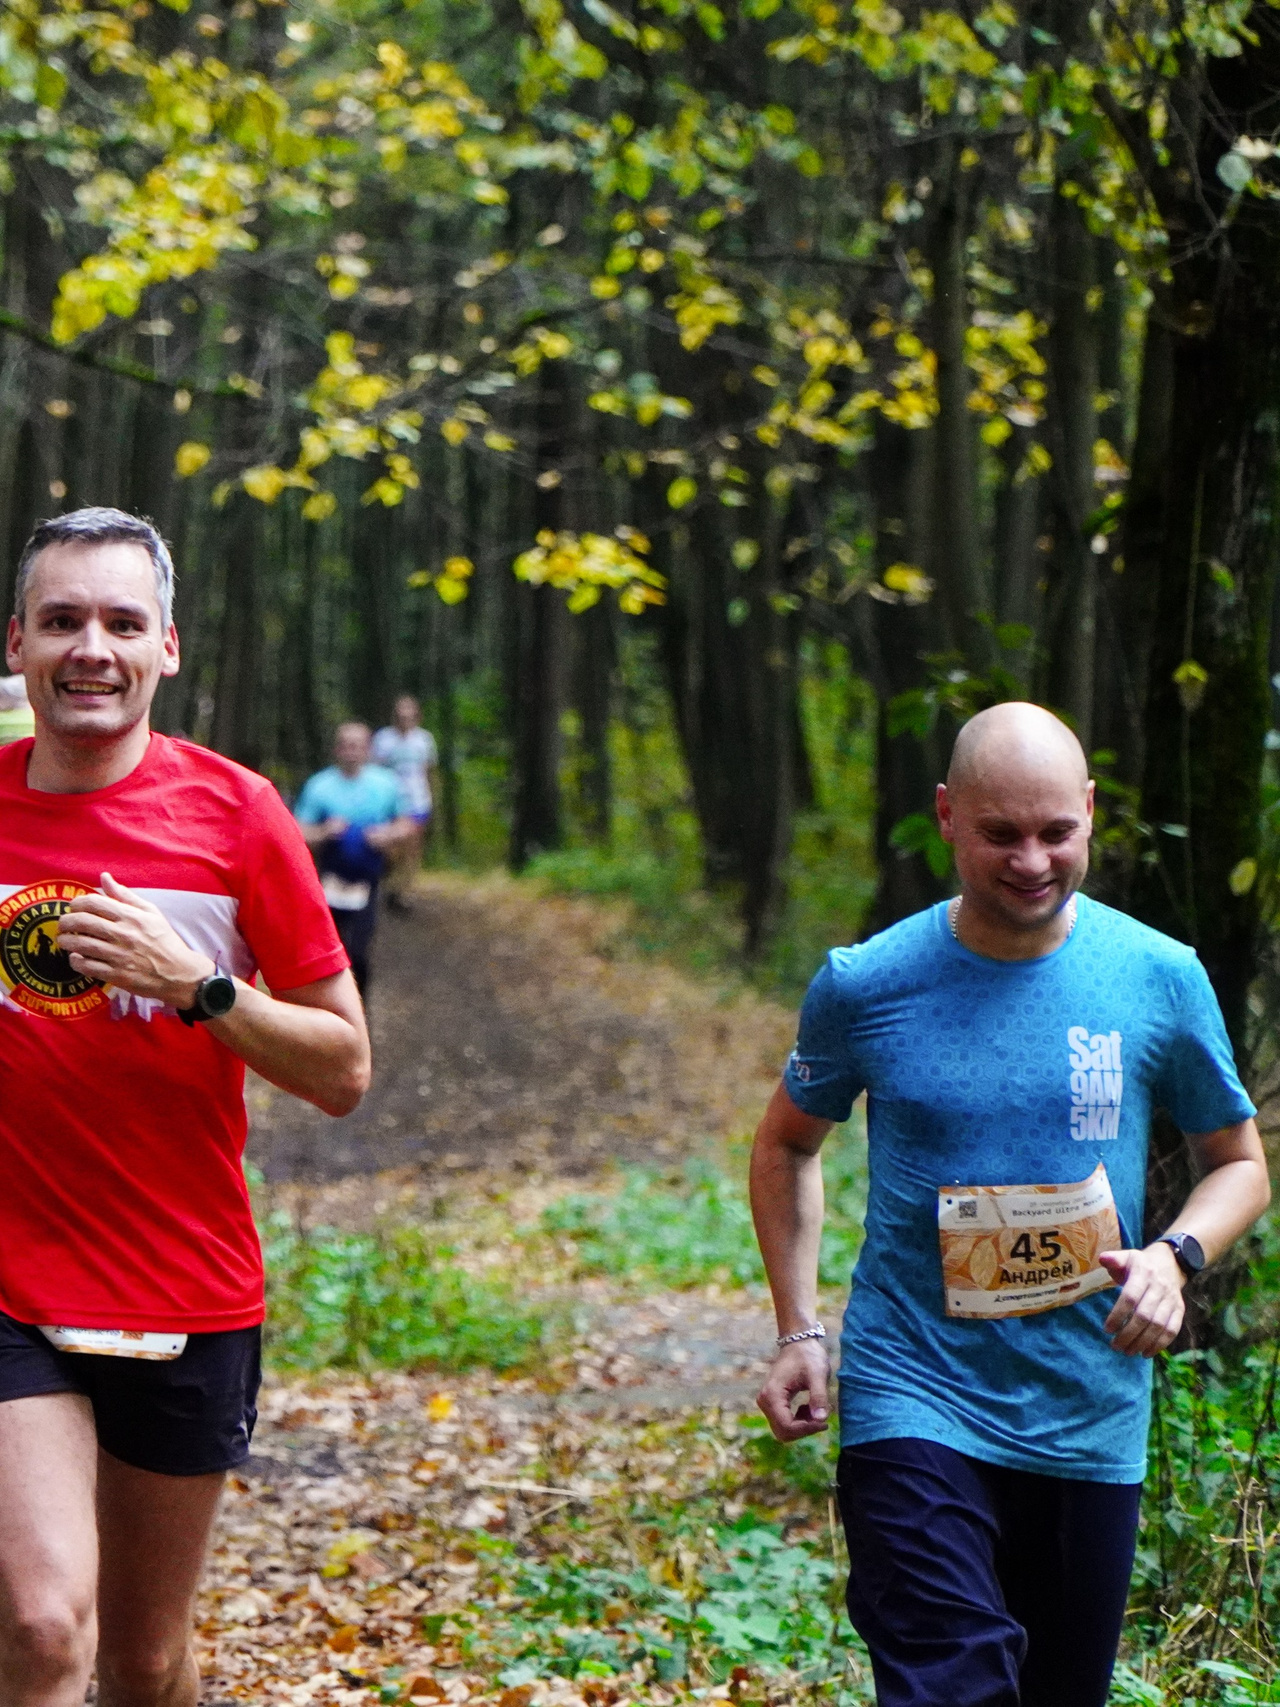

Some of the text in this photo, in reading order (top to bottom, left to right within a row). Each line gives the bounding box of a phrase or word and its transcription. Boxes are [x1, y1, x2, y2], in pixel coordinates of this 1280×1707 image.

[17, 989, 103, 1017] SUPPORTERS
[1067, 1025, 1123, 1071] Sat
[1069, 1070, 1123, 1106] 9AM
[1069, 1106, 1121, 1141] 5KM
[1012, 1207, 1052, 1218] Backyard
[1010, 1230, 1062, 1263] 45
[999, 1260, 1073, 1285] Андрей
